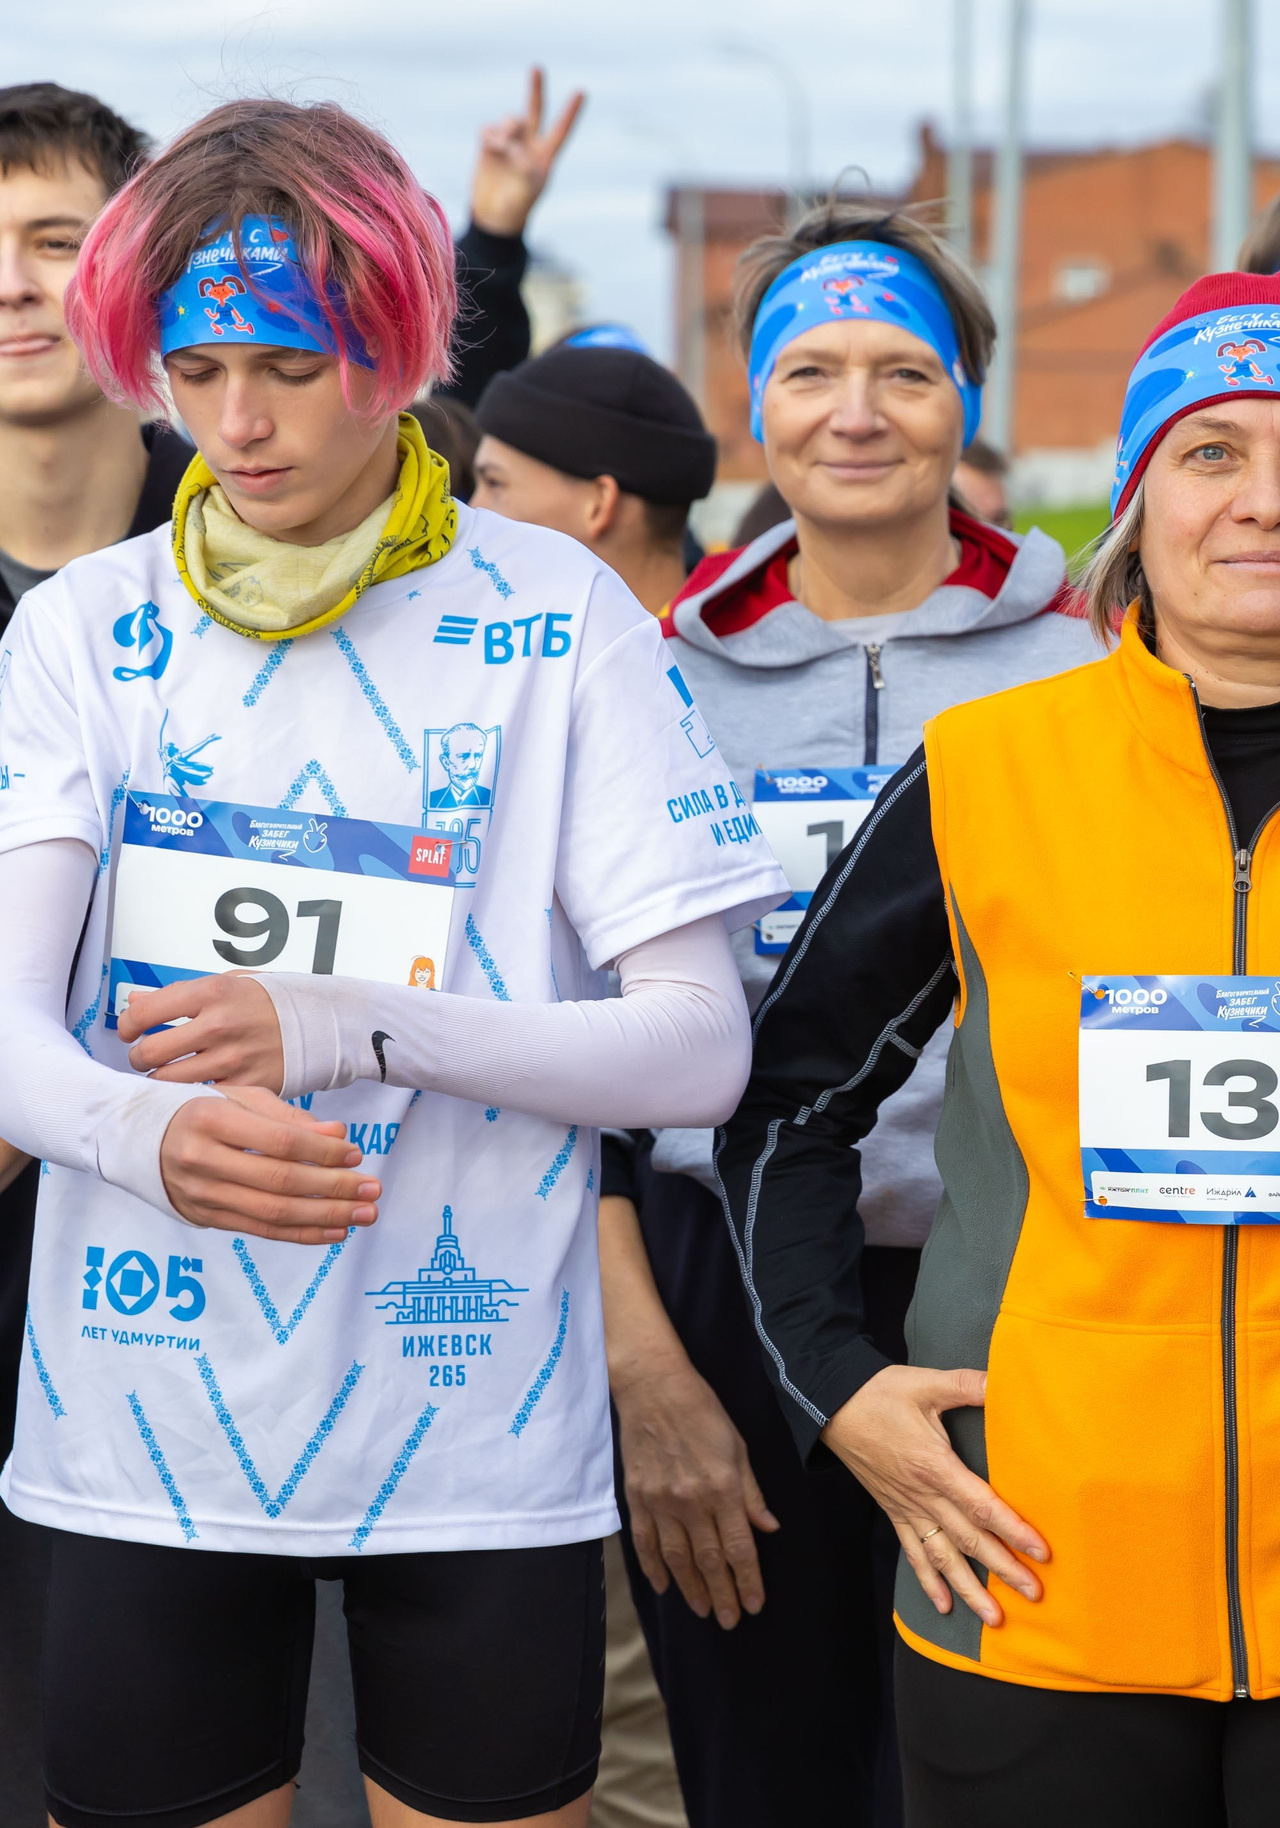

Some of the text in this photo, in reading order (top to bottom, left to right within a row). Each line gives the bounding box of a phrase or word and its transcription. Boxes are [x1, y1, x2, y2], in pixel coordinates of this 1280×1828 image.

[484, 612, 573, 665] ВТБ
[775, 775, 828, 789] 1000
[667, 789, 715, 823] СИЛА
[713, 784, 729, 809] В
[149, 806, 203, 829] 1000
[151, 823, 194, 837] метров
[262, 829, 290, 839] ЗАБЕГ
[710, 812, 763, 846] И ЕДИ
[248, 835, 300, 850] Кузнечики
[213, 887, 343, 975] 91
[1105, 988, 1168, 1005] 1000
[1229, 997, 1258, 1006] ЗАБЕГ
[1112, 1006, 1160, 1016] метров
[1217, 1005, 1268, 1021] Кузнечики
[1159, 1186, 1196, 1195] centre
[81, 1325, 200, 1351] ЛЕТ УДМУРТИИ
[402, 1333, 492, 1358] ИЖЕВСК
[429, 1364, 467, 1387] 265
